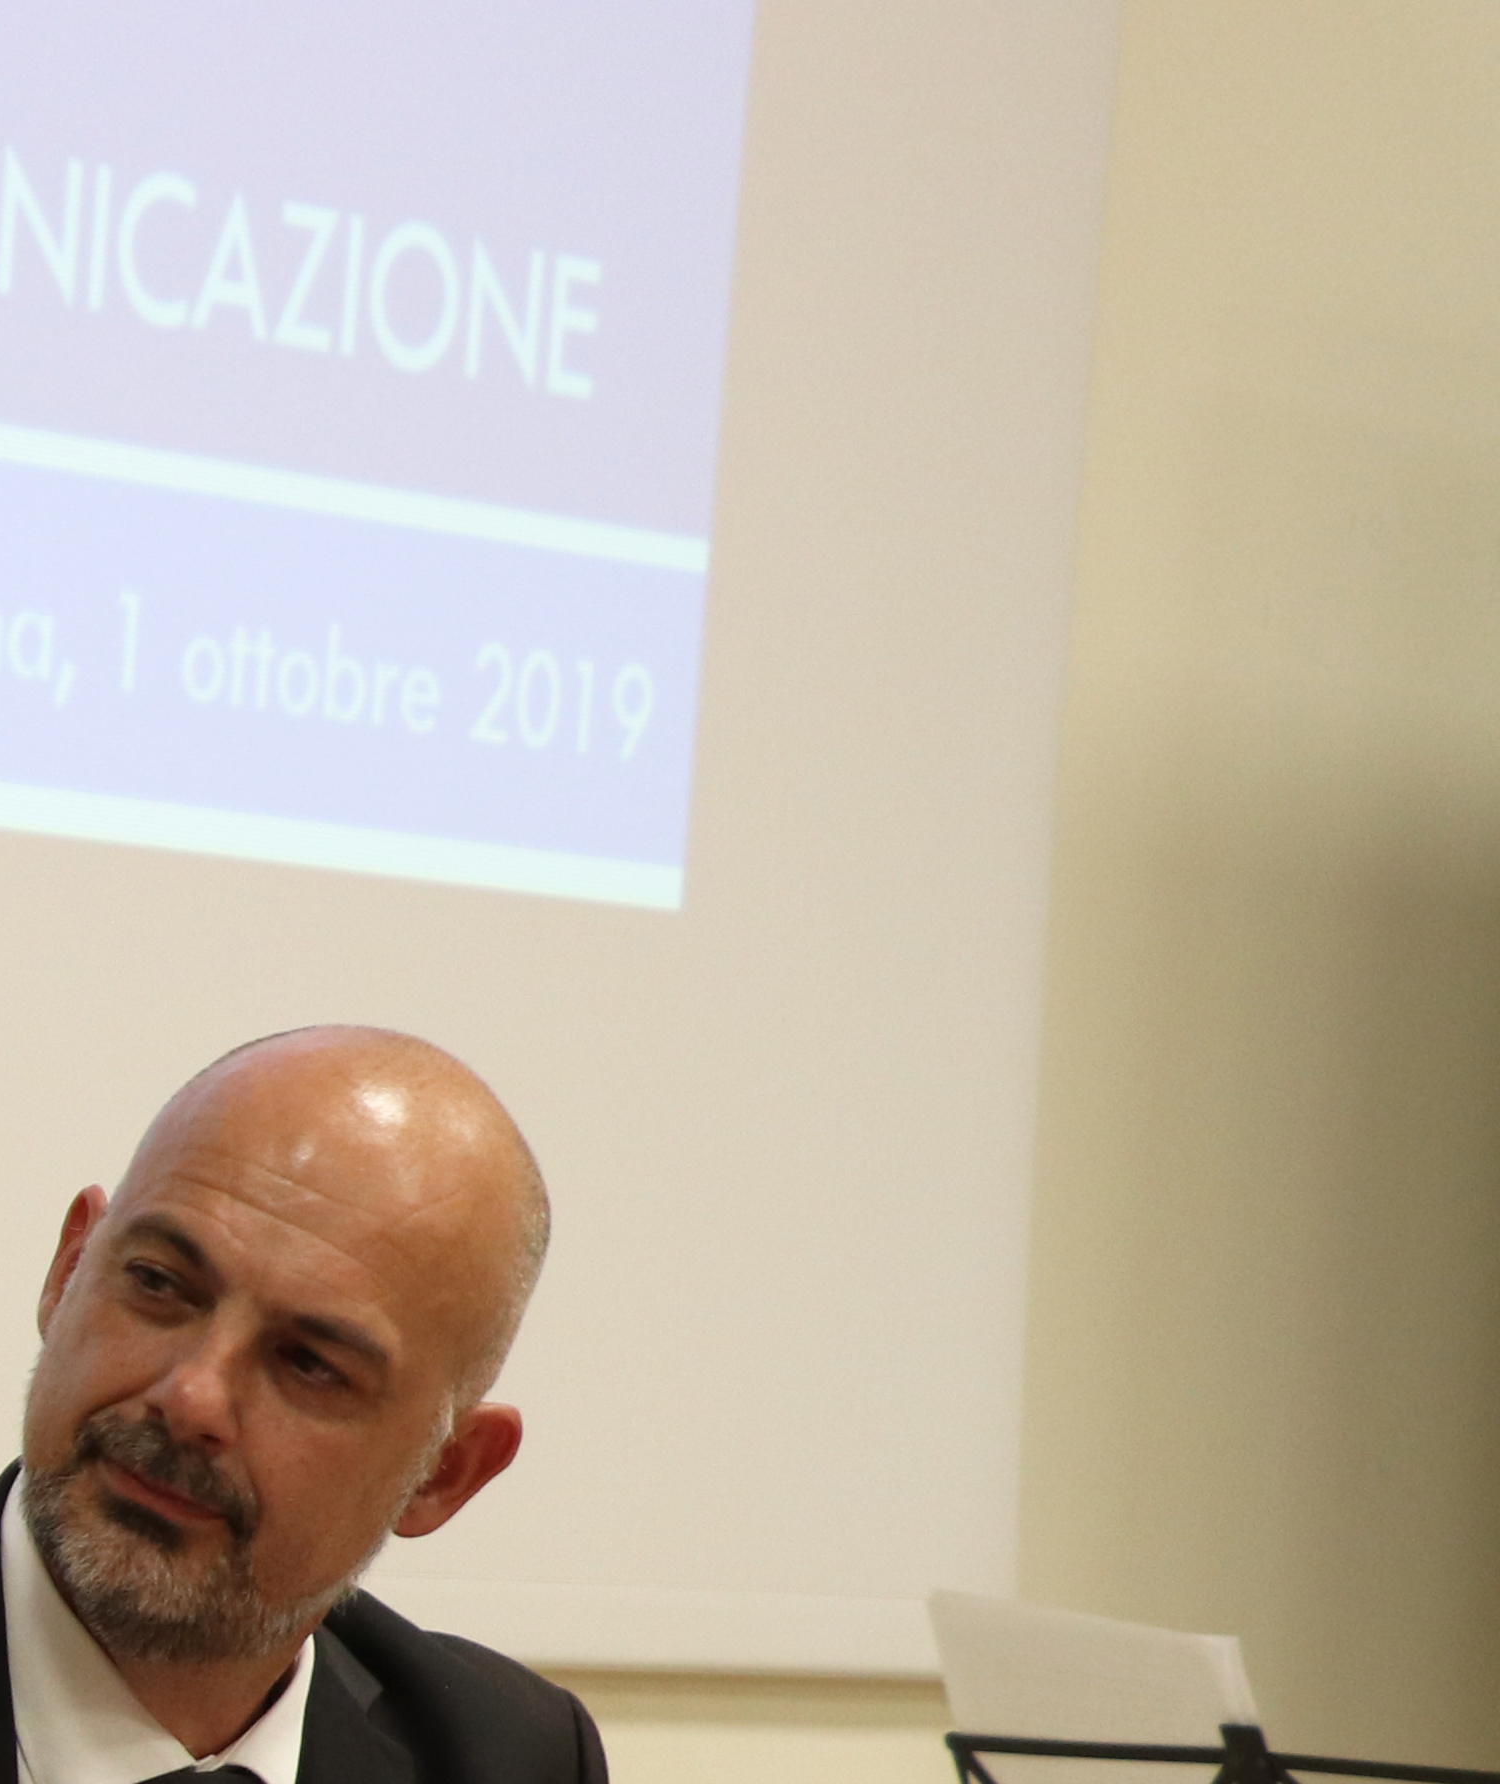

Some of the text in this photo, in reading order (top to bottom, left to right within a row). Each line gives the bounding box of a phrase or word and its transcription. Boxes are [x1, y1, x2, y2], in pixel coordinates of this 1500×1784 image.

[118, 590, 142, 693] 1
[181, 622, 442, 733] ottobre
[470, 641, 656, 763] 2019
